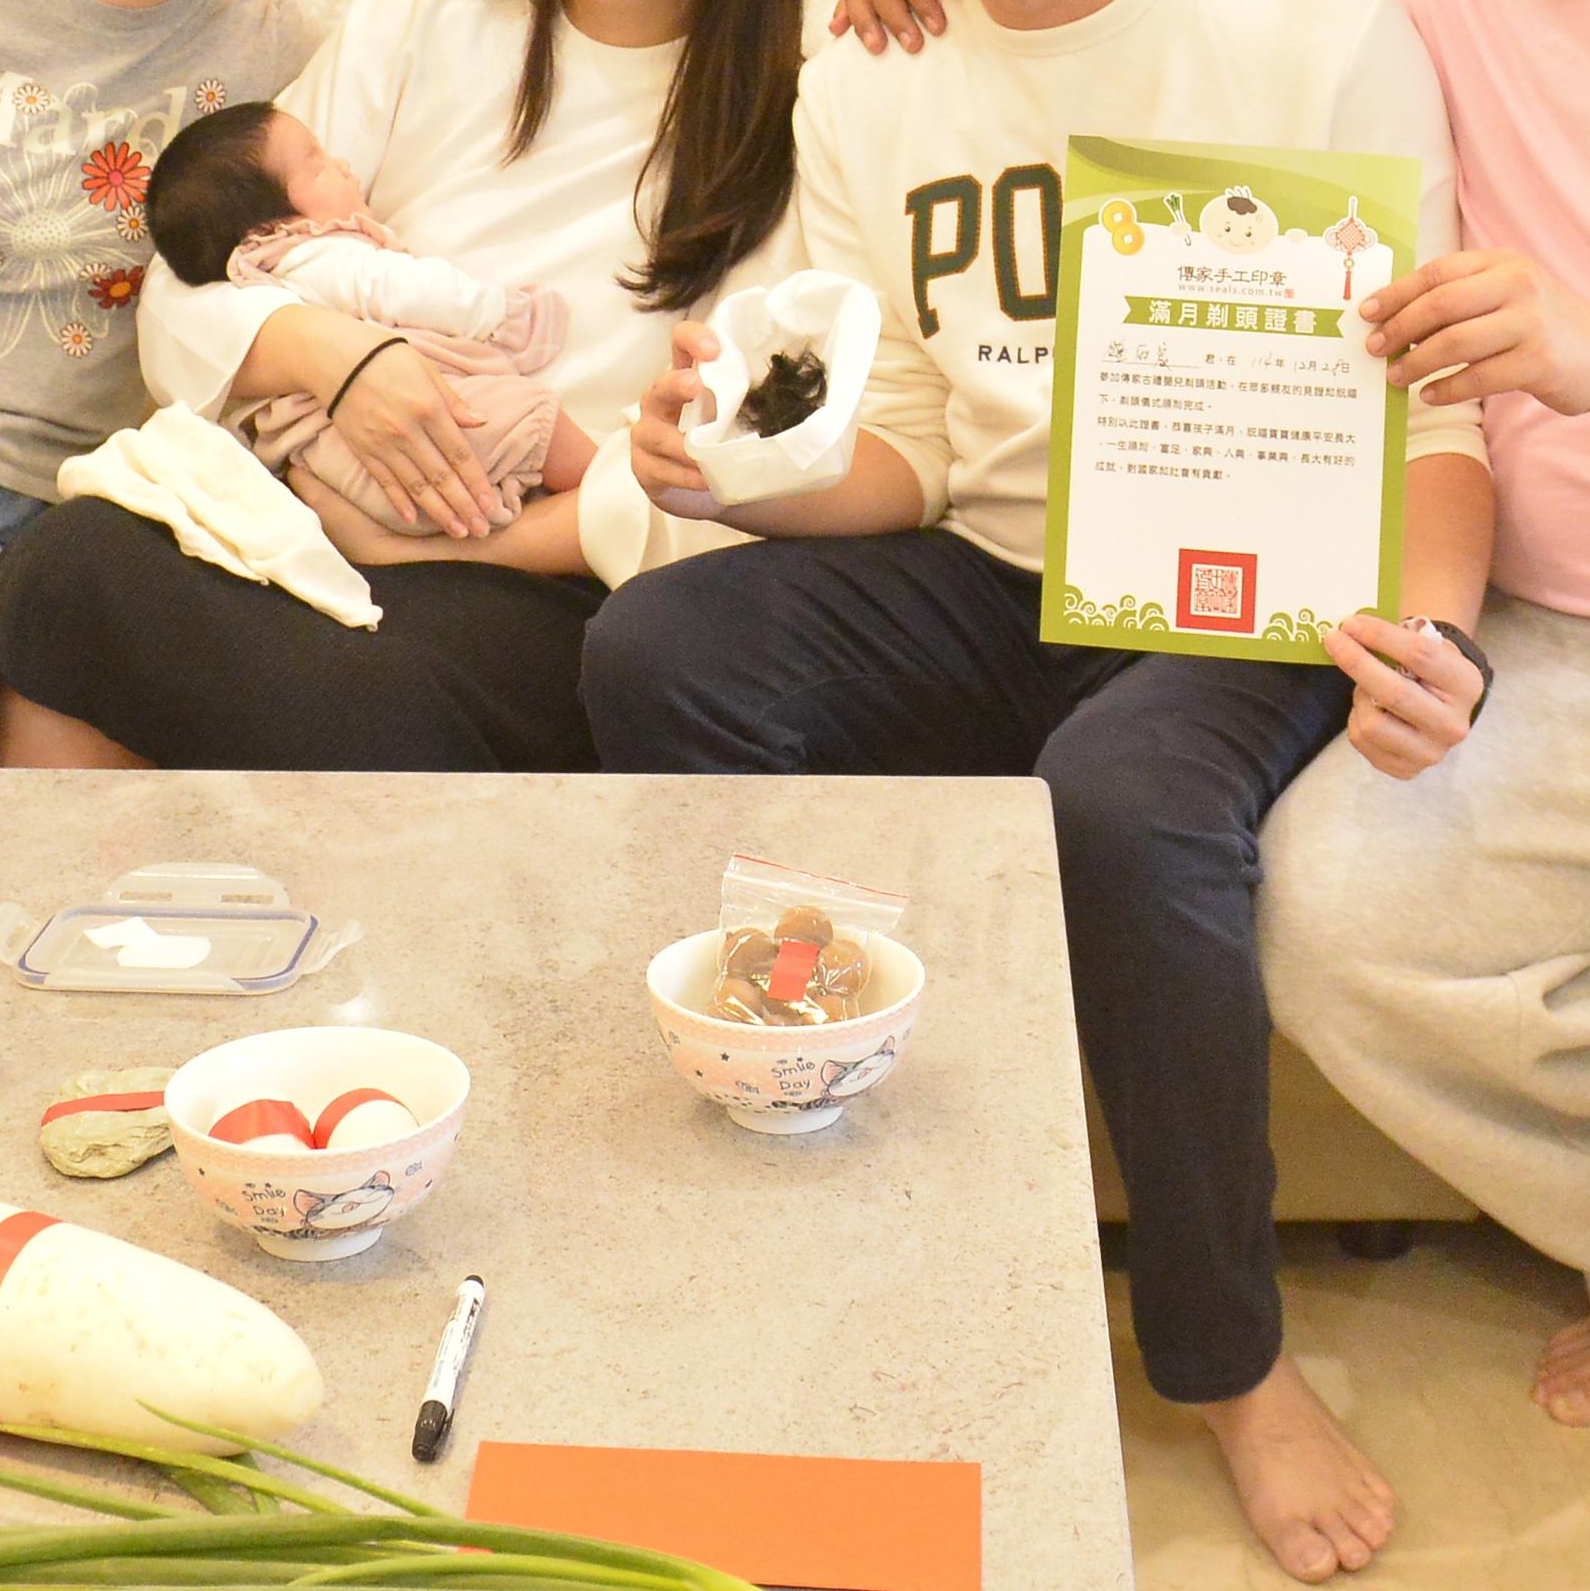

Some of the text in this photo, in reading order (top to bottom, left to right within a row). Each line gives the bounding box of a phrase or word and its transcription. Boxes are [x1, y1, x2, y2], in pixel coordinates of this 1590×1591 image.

[905, 162, 1064, 339] PO
[1177, 265, 1287, 286] 傳家手工印章
[1178, 283, 1283, 297] www.seals.com.tw
[1149, 299, 1318, 335] 滿月剃頭證書
[978, 344, 1055, 364] RALP
[779, 1079, 811, 1091] Day
[252, 1205, 286, 1218] Day
